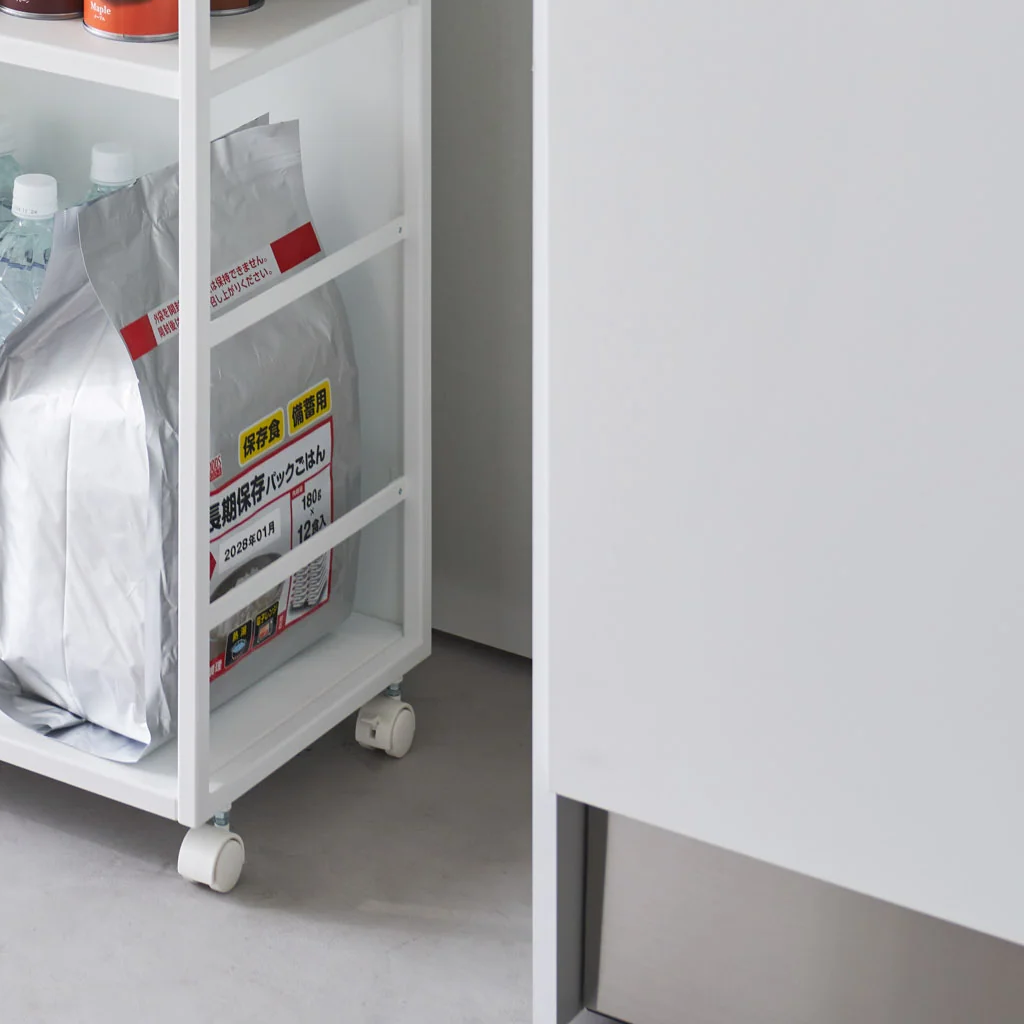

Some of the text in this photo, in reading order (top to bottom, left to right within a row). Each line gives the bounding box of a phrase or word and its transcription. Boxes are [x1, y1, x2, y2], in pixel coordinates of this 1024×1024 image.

[89, 0, 112, 15] Maple
[292, 388, 327, 427] 備蓄用
[243, 418, 281, 458] 保存食
[301, 488, 322, 510] 180g
[224, 520, 275, 562] 2028年01月
